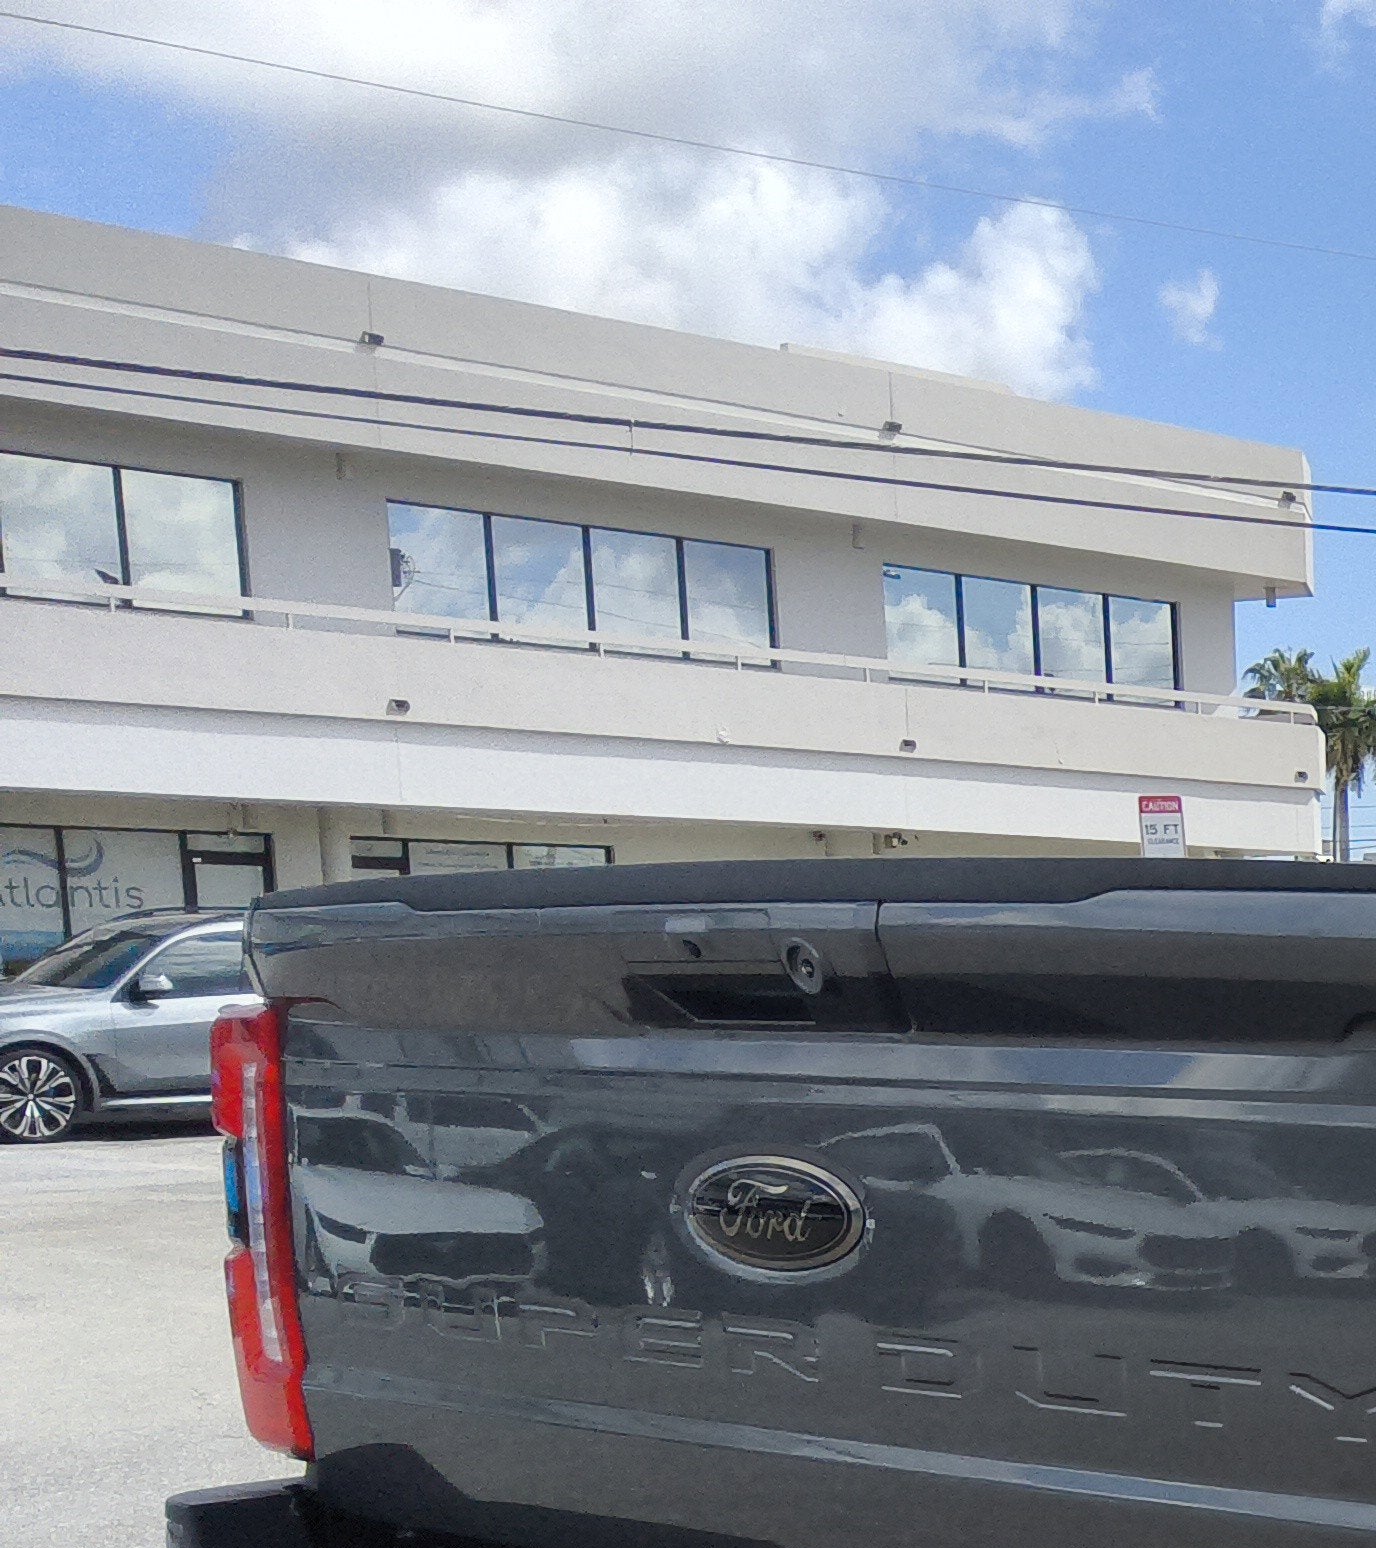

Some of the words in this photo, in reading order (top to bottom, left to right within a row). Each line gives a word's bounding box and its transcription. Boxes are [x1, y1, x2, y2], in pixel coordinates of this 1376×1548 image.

[1141, 800, 1179, 811] CAUTION
[1144, 823, 1158, 836] 15
[1163, 823, 1180, 835] FT
[0, 876, 144, 909] tlantis
[720, 1178, 812, 1242] Ford
